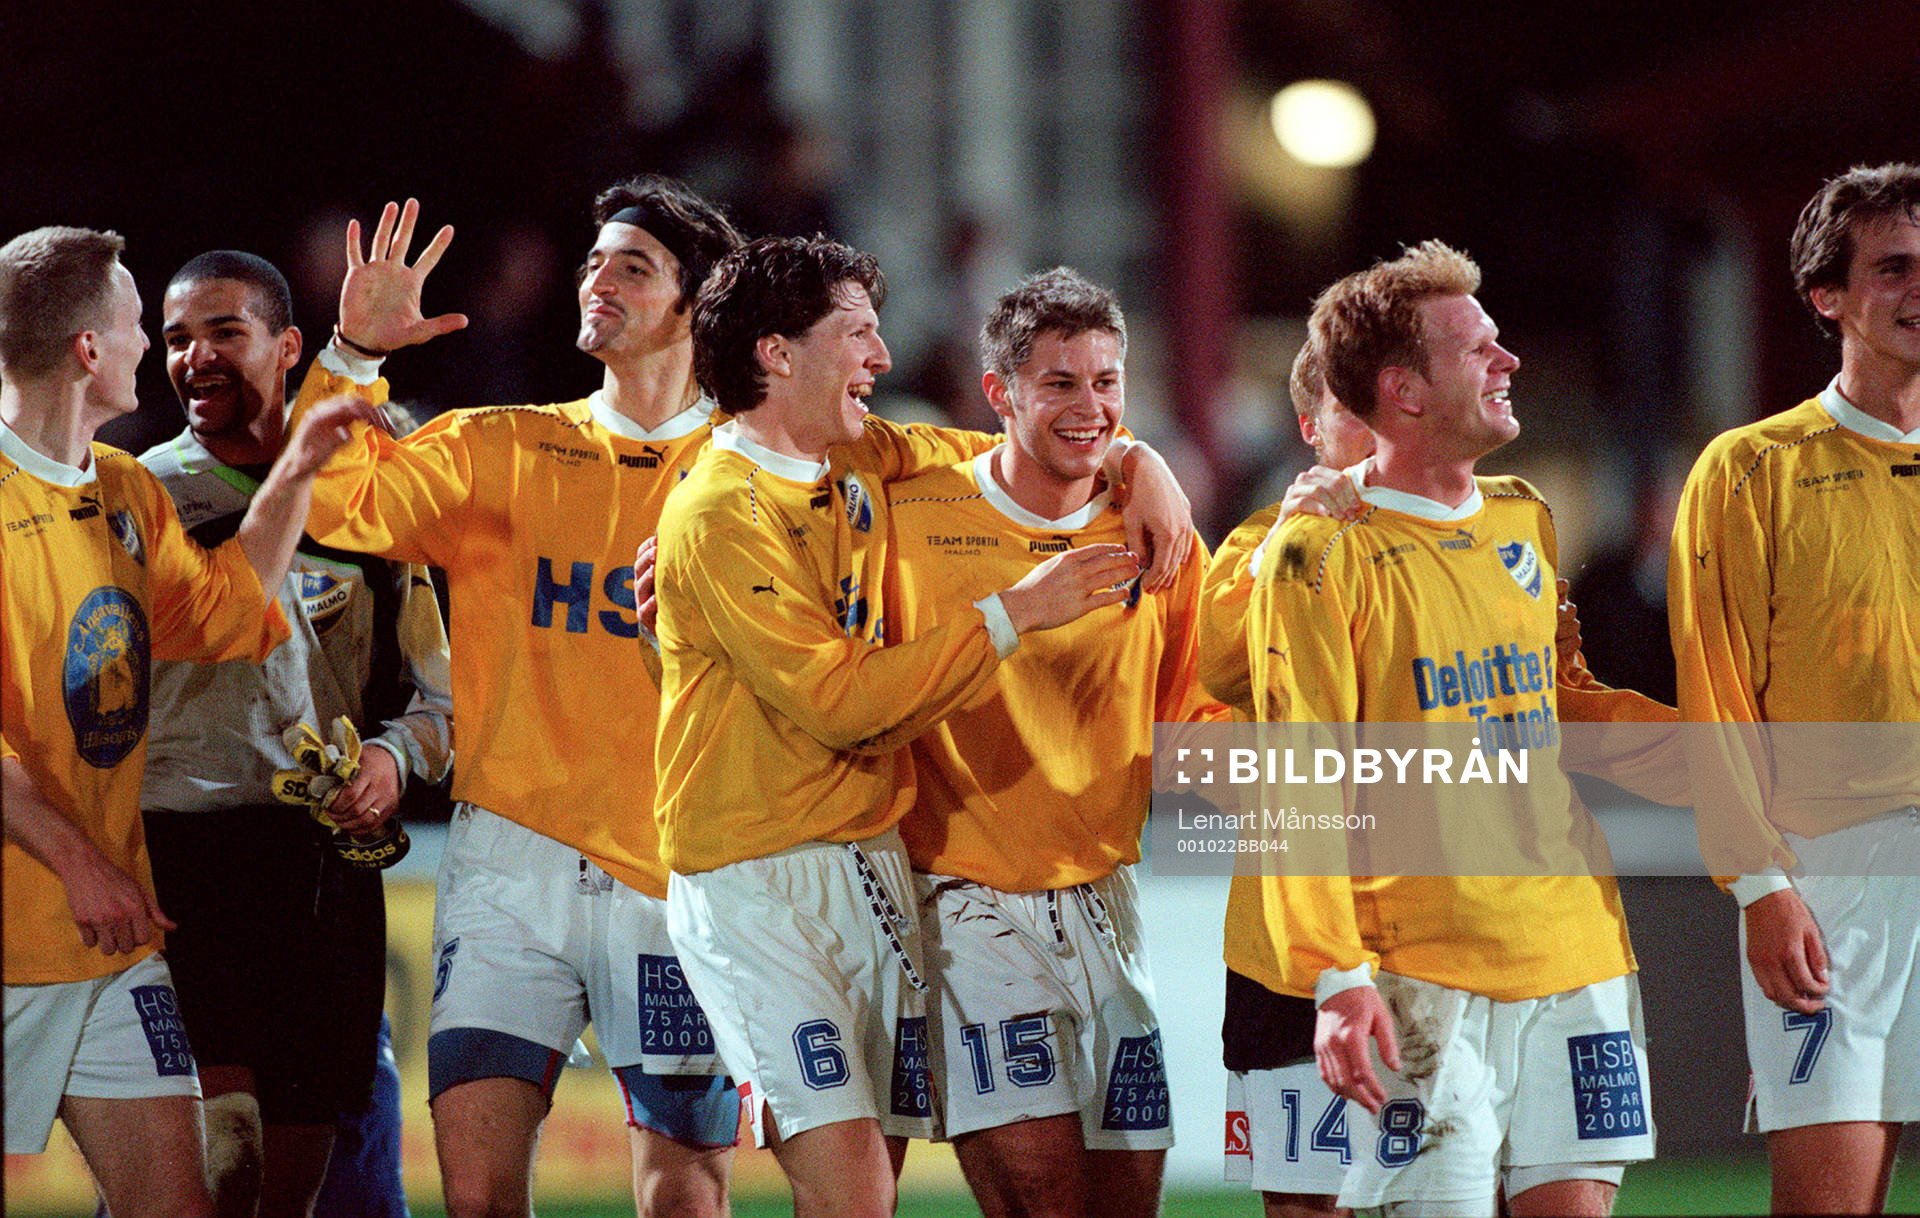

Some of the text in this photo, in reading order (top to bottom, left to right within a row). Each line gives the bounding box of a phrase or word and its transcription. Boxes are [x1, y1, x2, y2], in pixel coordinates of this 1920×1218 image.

[618, 453, 659, 468] PUMA
[69, 504, 101, 521] PUMA
[927, 535, 1000, 547] TEAM SPORTIA
[1029, 540, 1069, 552] PUMA
[532, 556, 639, 638] HS
[1412, 643, 1543, 712] Deloitte
[1468, 695, 1559, 758] Touch
[644, 962, 683, 990] HS
[139, 990, 177, 1016] HS
[645, 1009, 672, 1027] 75
[155, 1033, 181, 1049] 75
[645, 1029, 709, 1047] 2000
[900, 1026, 928, 1052] HS
[1782, 1007, 1833, 1085] 7
[792, 1018, 851, 1091] 6
[960, 1016, 1057, 1096] 15
[1575, 1039, 1634, 1072] HSB
[899, 1072, 925, 1090] 75
[1580, 1067, 1638, 1090] MALMÖ
[1113, 1086, 1138, 1103] 75
[1583, 1092, 1612, 1110] 75
[1110, 1104, 1167, 1122] 2000
[1584, 1109, 1641, 1131] 2000
[1281, 1088, 1352, 1165] 14
[1375, 1097, 1436, 1169] 8
